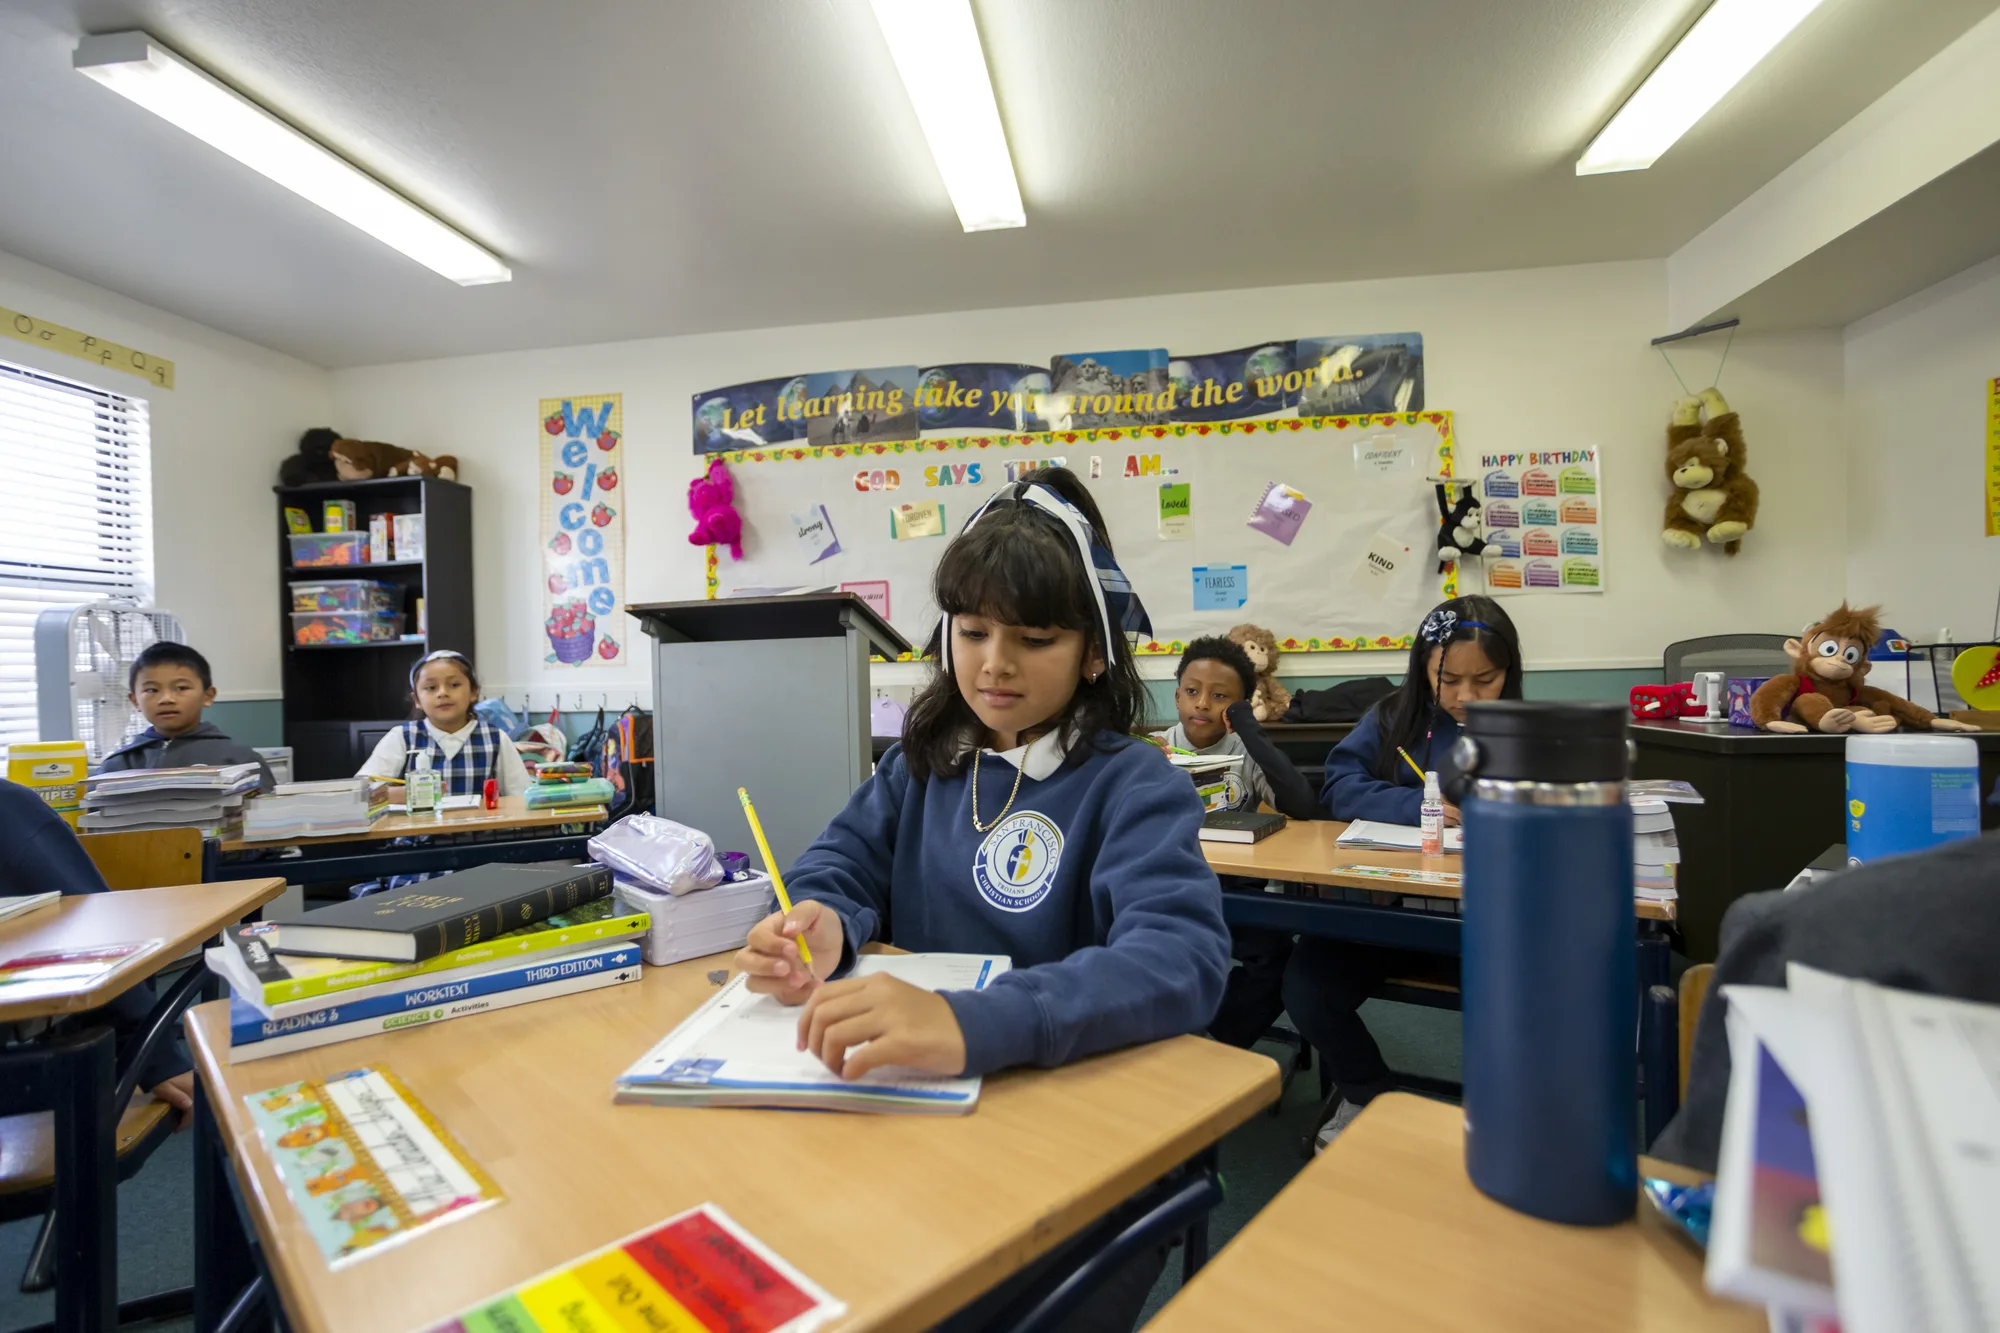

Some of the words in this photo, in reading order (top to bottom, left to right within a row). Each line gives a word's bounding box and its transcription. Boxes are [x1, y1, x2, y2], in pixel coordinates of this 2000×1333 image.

[722, 403, 767, 431] Let
[777, 385, 904, 422] learning
[913, 380, 983, 408] take
[1060, 383, 1177, 414] around
[1190, 378, 1244, 408] the
[1255, 356, 1364, 399] world.
[1364, 450, 1403, 460] CONFIDENT
[1482, 453, 1524, 467] HAPPY
[1529, 450, 1595, 465] BIRTHDAY
[854, 470, 900, 491] GOD
[924, 463, 982, 487] SAYS
[1091, 456, 1101, 478] I
[560, 400, 615, 616] Welcome
[1162, 498, 1188, 509] Loved
[798, 520, 824, 538] strong
[1367, 552, 1395, 571] KIND
[1204, 577, 1235, 588] FEARLESS
[990, 826, 1010, 846] SAN
[1012, 819, 1058, 864] FRANCISCO
[980, 874, 1013, 905] CHRISTIAN
[1014, 888, 1045, 906] SCHOOL
[997, 882, 1026, 895] TROJANS
[463, 916, 471, 945] HOLY
[470, 913, 480, 942] BIBLE
[456, 949, 493, 962] Activities
[262, 1011, 327, 1035] READING
[405, 982, 469, 1006] WORKTEXT
[525, 963, 560, 982] THIRD
[560, 957, 603, 975] EDITION
[384, 1012, 429, 1028] SCIENCE
[451, 1001, 489, 1014] Activities
